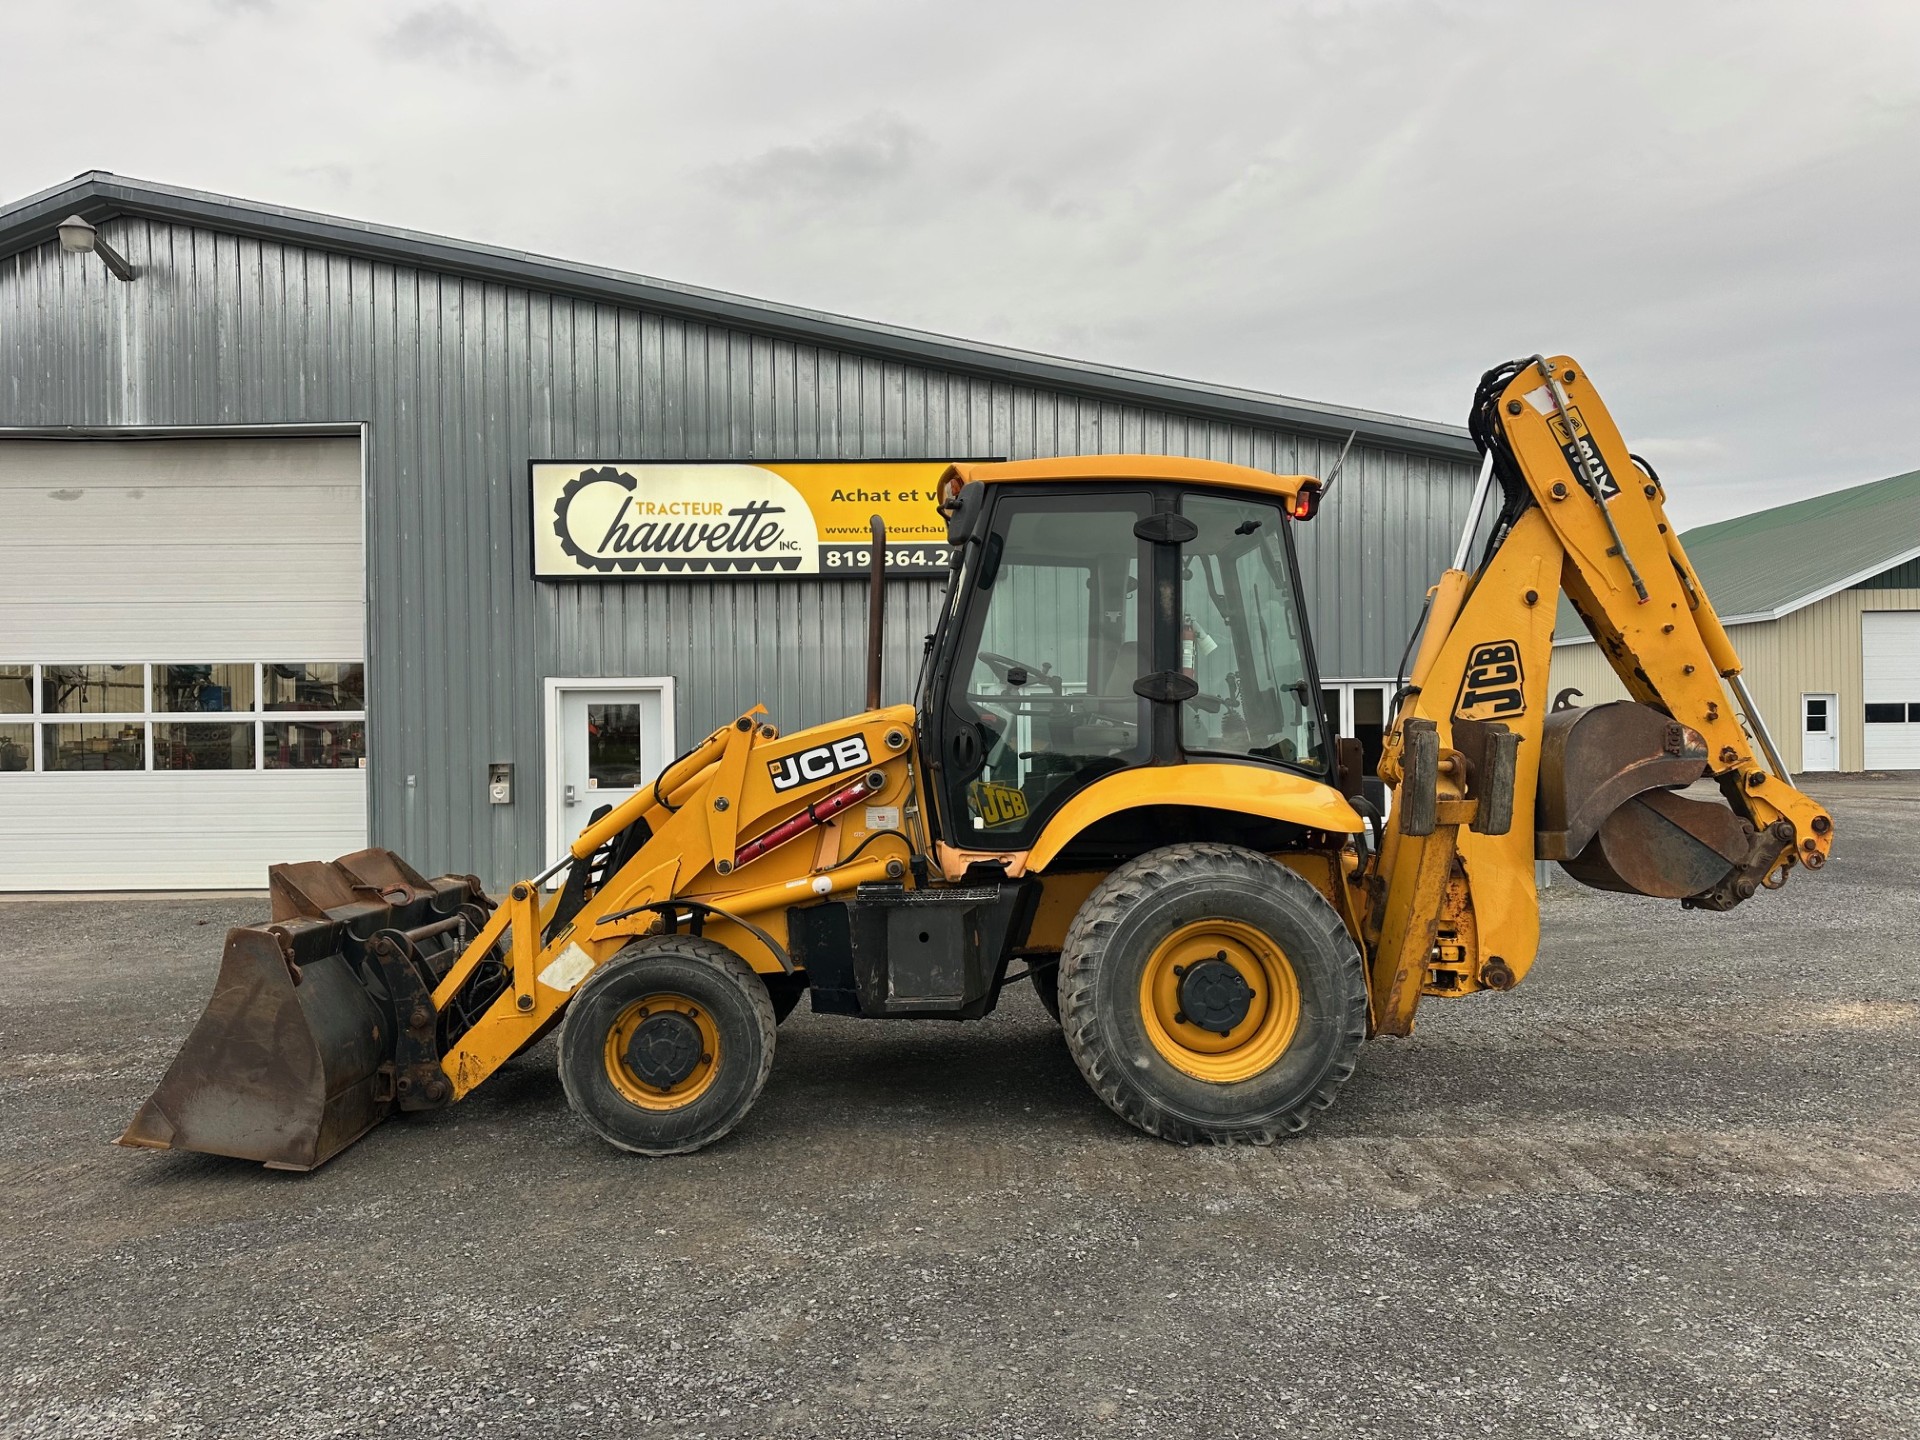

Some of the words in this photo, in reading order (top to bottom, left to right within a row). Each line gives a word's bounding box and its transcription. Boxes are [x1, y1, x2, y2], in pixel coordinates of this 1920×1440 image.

[830, 488, 891, 502] Achat
[898, 490, 919, 502] et
[925, 491, 938, 501] v
[635, 501, 724, 516] TRACTEUR
[779, 540, 802, 551] INC.
[1461, 645, 1523, 714] JCB
[773, 737, 869, 789] JCB
[982, 786, 1027, 823] JCB
